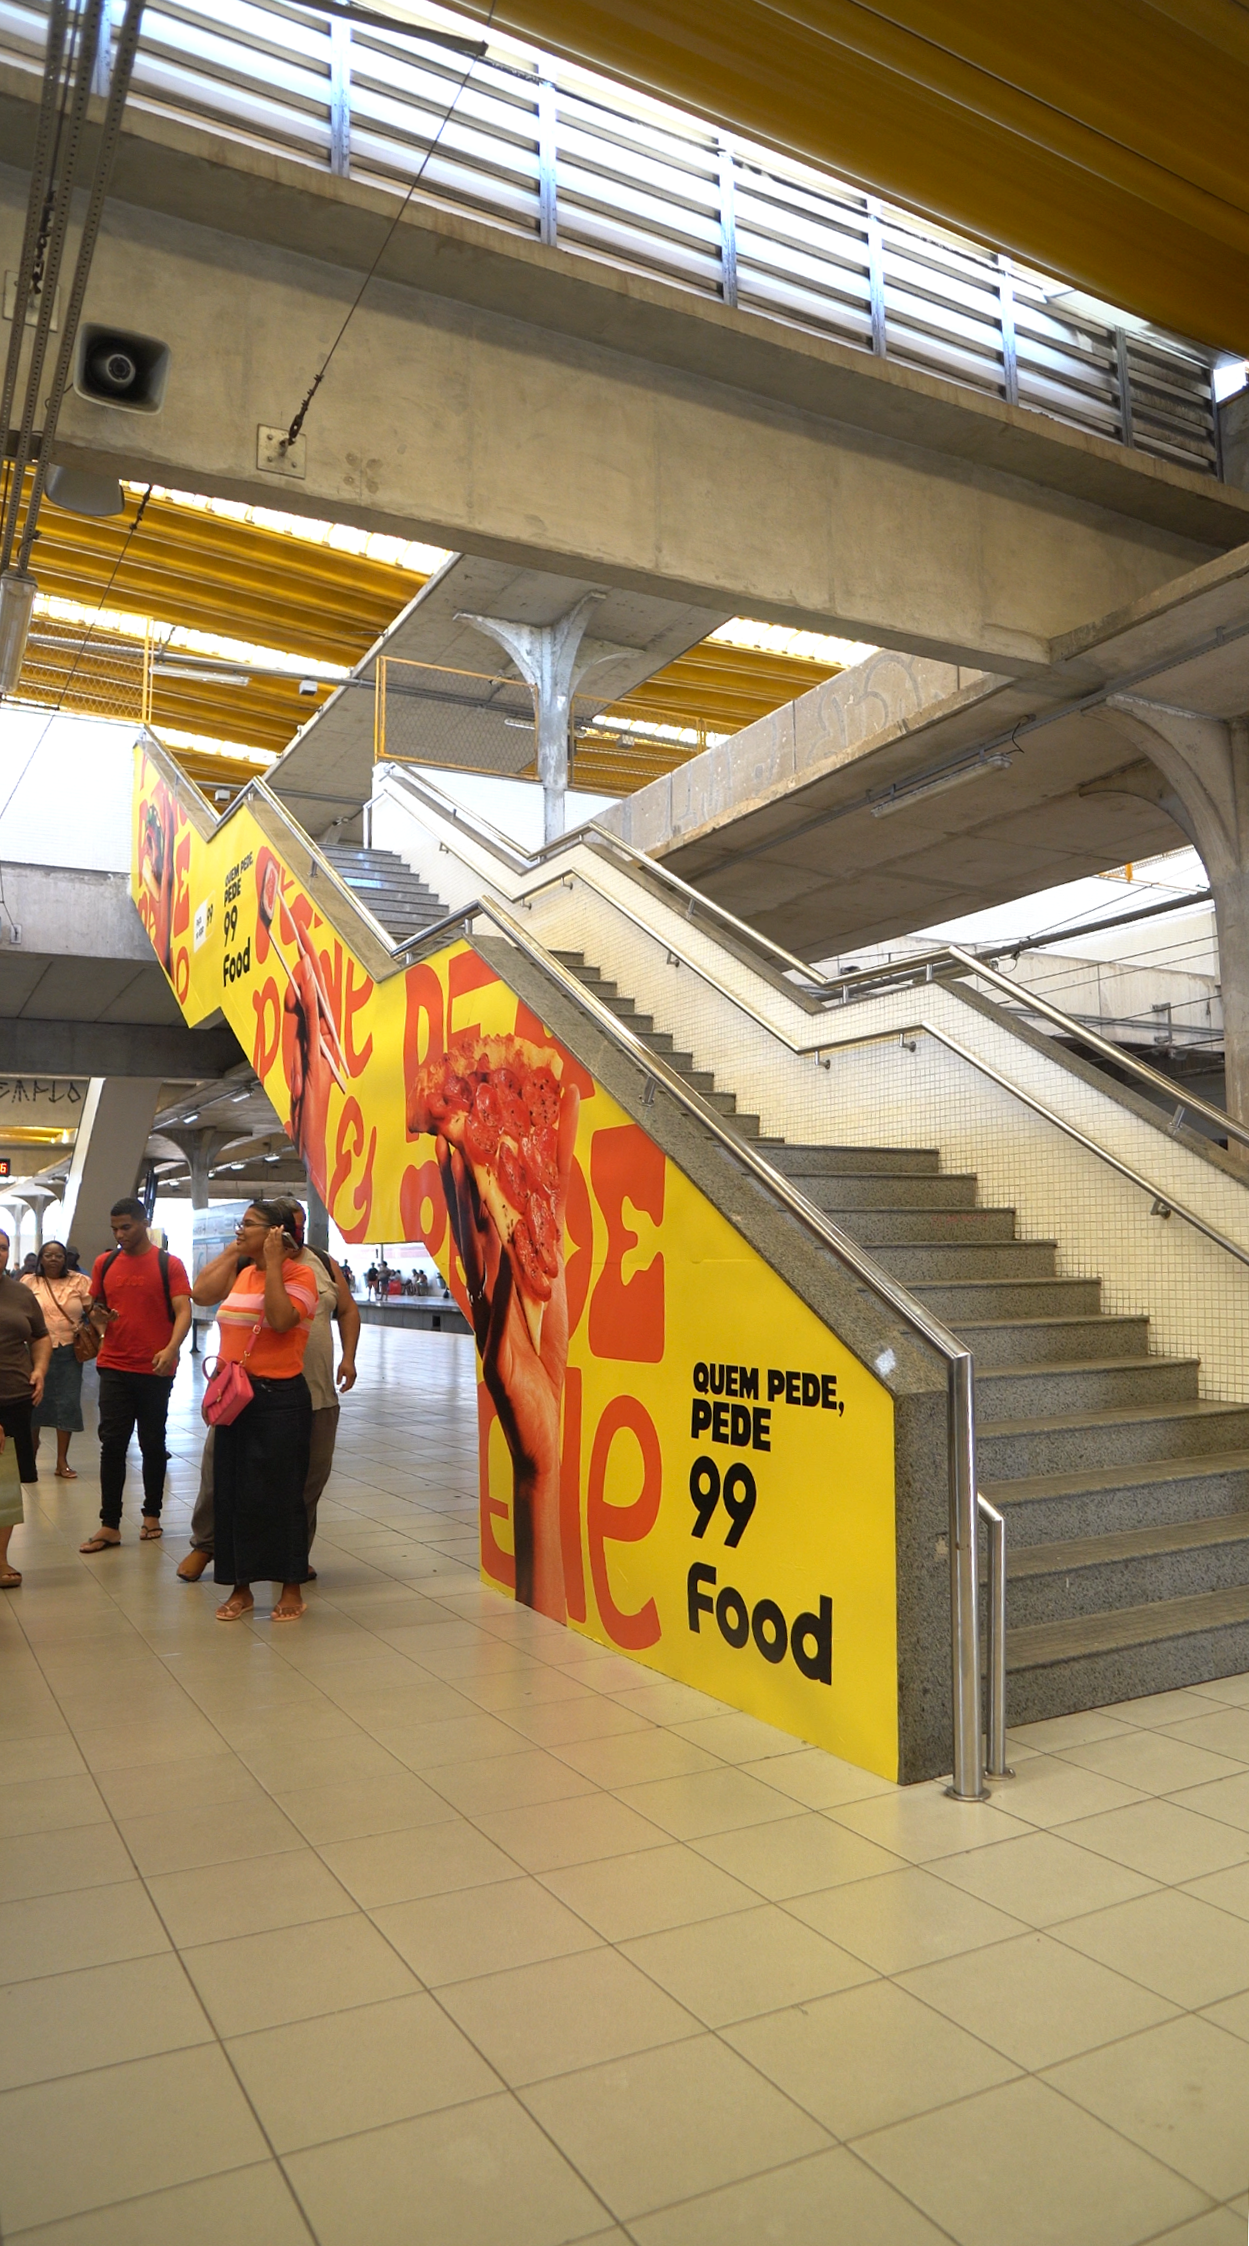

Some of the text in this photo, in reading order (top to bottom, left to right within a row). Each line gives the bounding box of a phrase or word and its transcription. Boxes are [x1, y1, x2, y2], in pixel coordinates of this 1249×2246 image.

[224, 877, 241, 907] PEDE
[224, 905, 238, 947] 99
[223, 936, 251, 988] Food
[693, 1361, 845, 1418] QUEM PEDE,
[691, 1397, 772, 1453] PEDE
[689, 1455, 757, 1549] 99
[687, 1561, 833, 1686] Food
